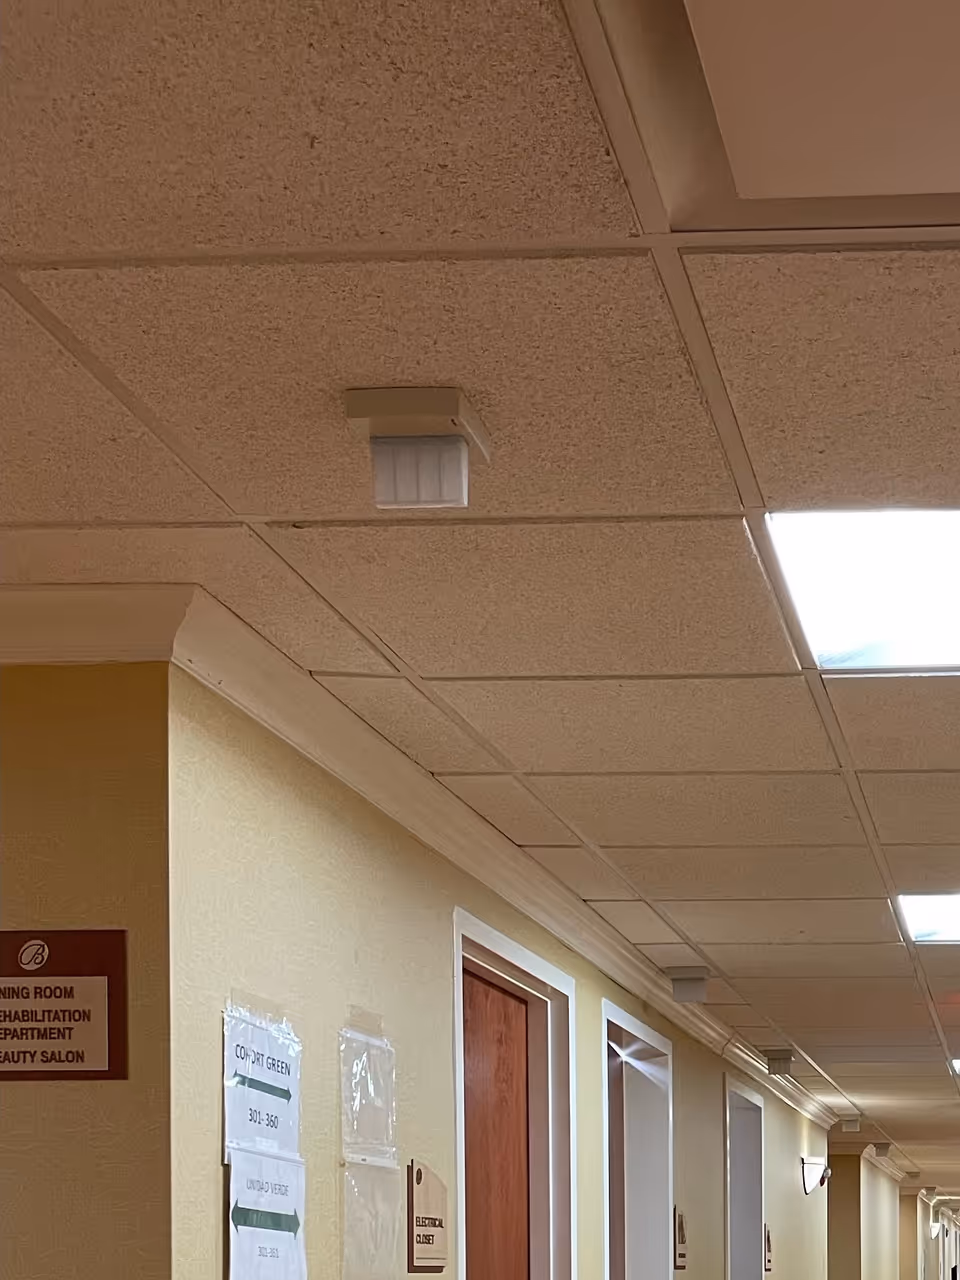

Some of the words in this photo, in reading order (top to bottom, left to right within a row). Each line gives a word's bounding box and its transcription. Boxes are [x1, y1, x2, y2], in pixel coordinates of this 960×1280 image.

[34, 986, 74, 999] ROOM
[40, 1050, 85, 1064] SALON
[235, 1043, 265, 1068] COHORT
[266, 1055, 291, 1077] GREEN
[415, 1216, 444, 1229] ELECTRICAL
[415, 1233, 435, 1245] CLOSET
